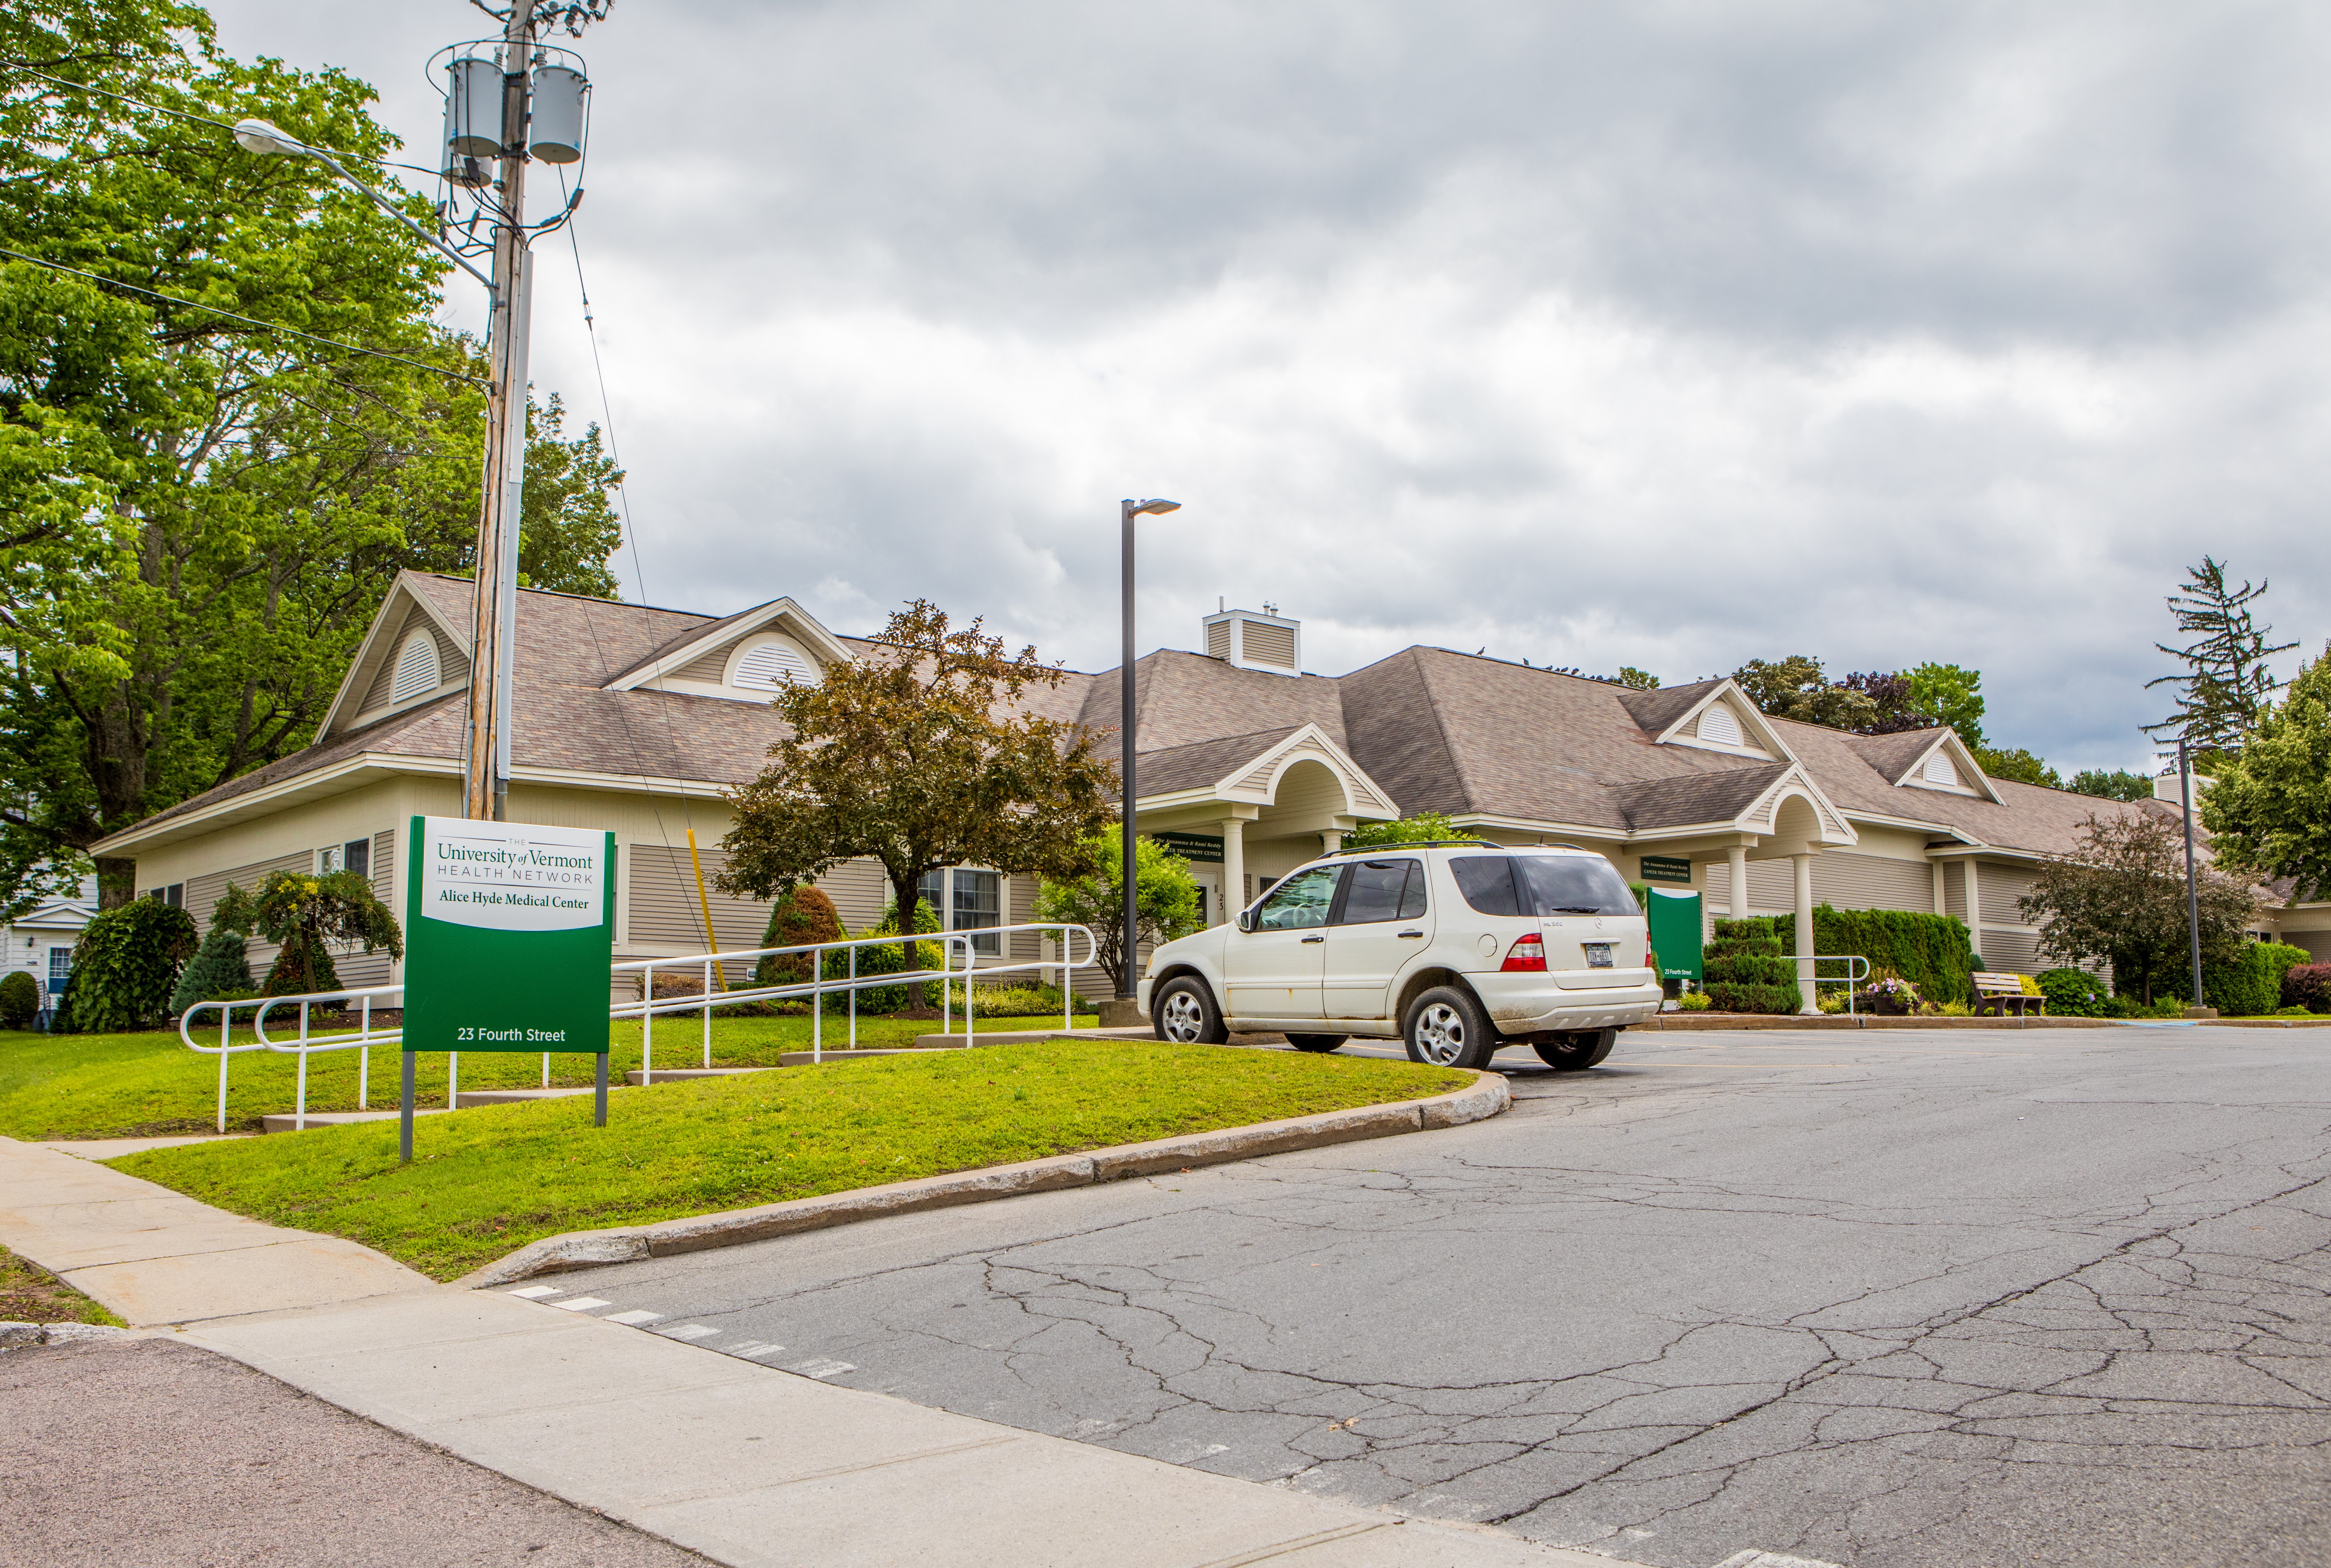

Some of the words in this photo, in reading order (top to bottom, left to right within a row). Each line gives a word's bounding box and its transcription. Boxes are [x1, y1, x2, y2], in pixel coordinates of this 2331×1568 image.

[438, 843, 517, 869] University
[518, 854, 528, 865] of
[529, 850, 593, 869] Vermont
[439, 865, 502, 878] HEALTH
[513, 870, 592, 884] NETWORK
[439, 890, 469, 902] Alice
[472, 892, 502, 907] Hyde
[505, 893, 549, 907] Medical
[552, 896, 589, 909] Center
[457, 1028, 474, 1040] 23
[478, 1028, 522, 1041] Fourth
[526, 1028, 565, 1041] Street
